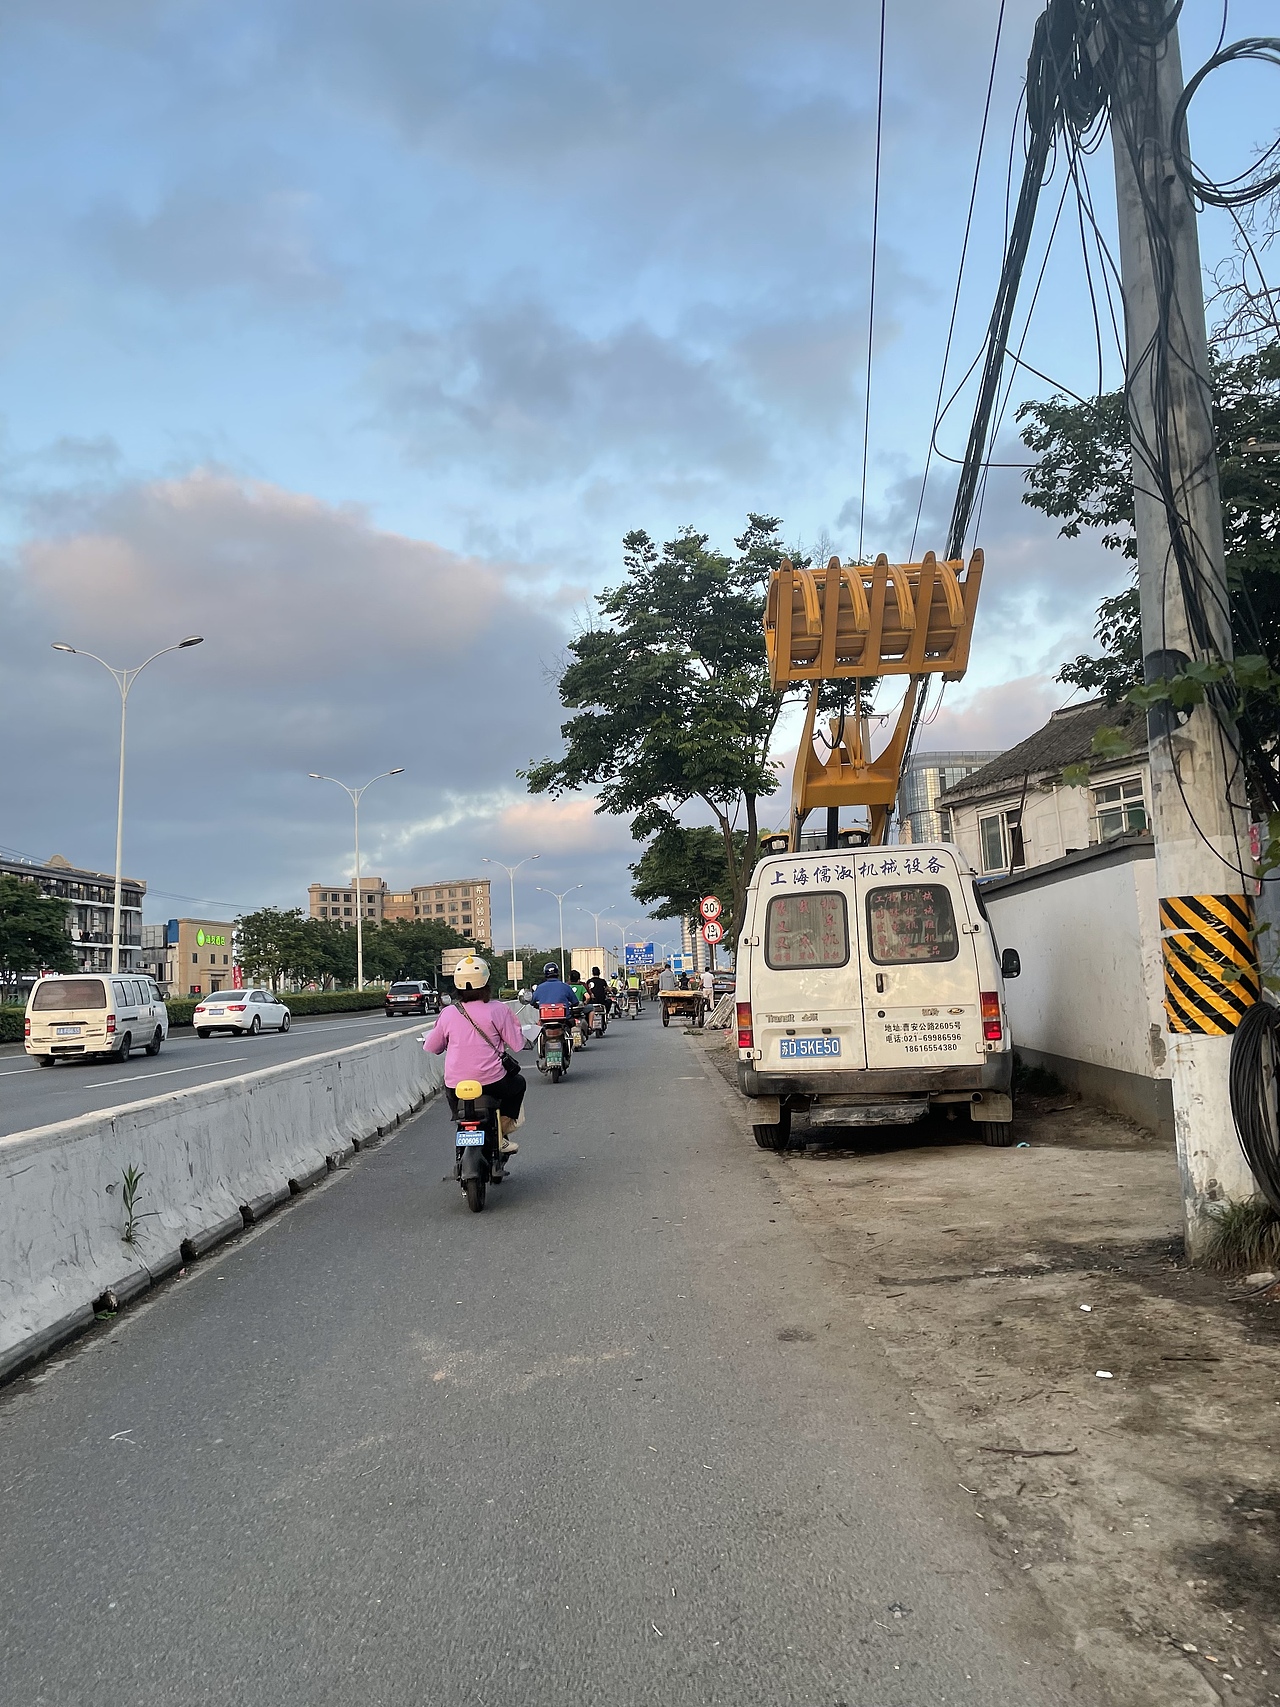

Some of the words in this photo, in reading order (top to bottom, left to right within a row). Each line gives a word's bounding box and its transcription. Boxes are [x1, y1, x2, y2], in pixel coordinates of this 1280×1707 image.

[770, 855, 946, 886] 上海儒淑机械设备
[765, 1014, 795, 1023] Transit
[904, 1043, 958, 1053] 18616554380
